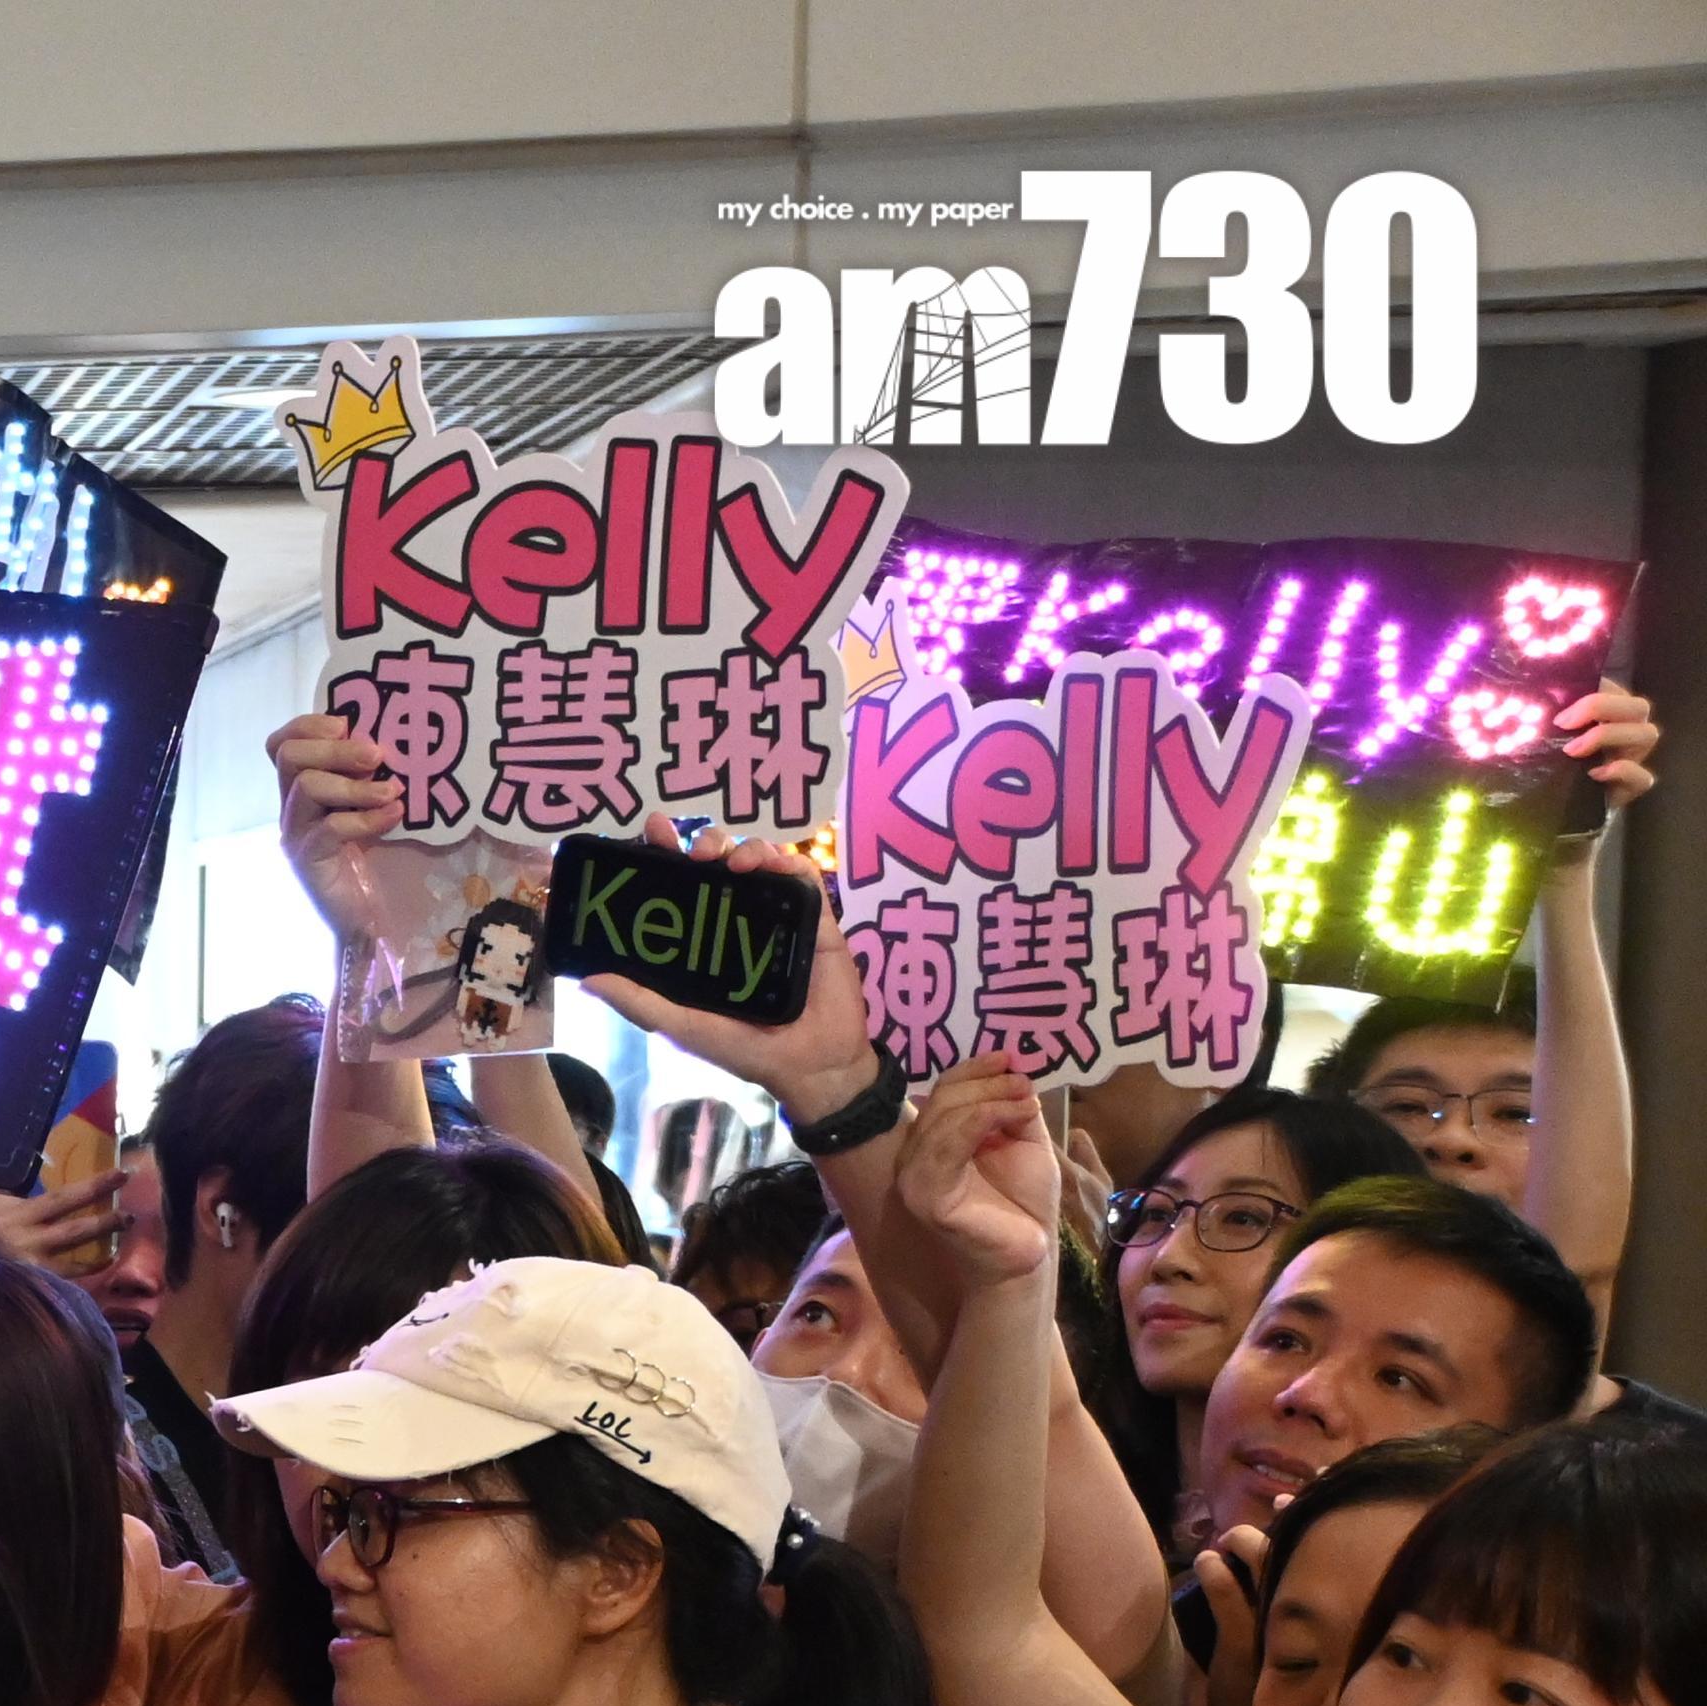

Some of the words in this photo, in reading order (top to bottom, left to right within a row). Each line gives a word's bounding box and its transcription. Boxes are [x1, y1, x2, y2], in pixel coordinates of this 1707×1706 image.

[335, 434, 885, 661] Kelly
[327, 640, 830, 832] 陳慧琳
[844, 668, 1292, 900] Kelly
[572, 858, 780, 1002] Kelly
[847, 880, 1255, 1080] 陳慧琳
